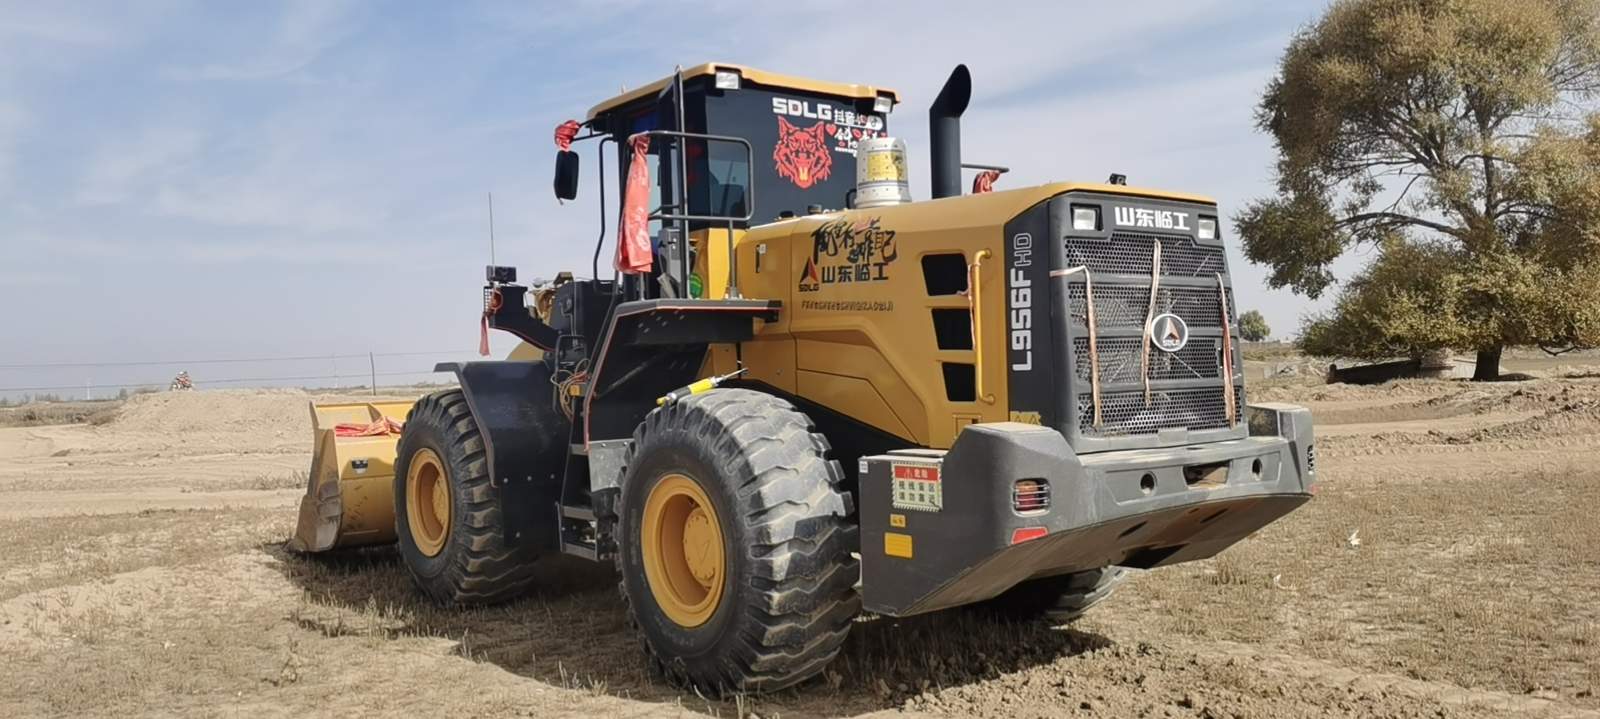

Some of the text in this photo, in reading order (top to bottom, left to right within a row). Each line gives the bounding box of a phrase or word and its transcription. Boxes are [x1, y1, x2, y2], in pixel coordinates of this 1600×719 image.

[772, 97, 832, 120] SDLG
[1114, 206, 1191, 231] 山东临工
[822, 262, 889, 283] 山东临工
[798, 283, 820, 292] SDLG
